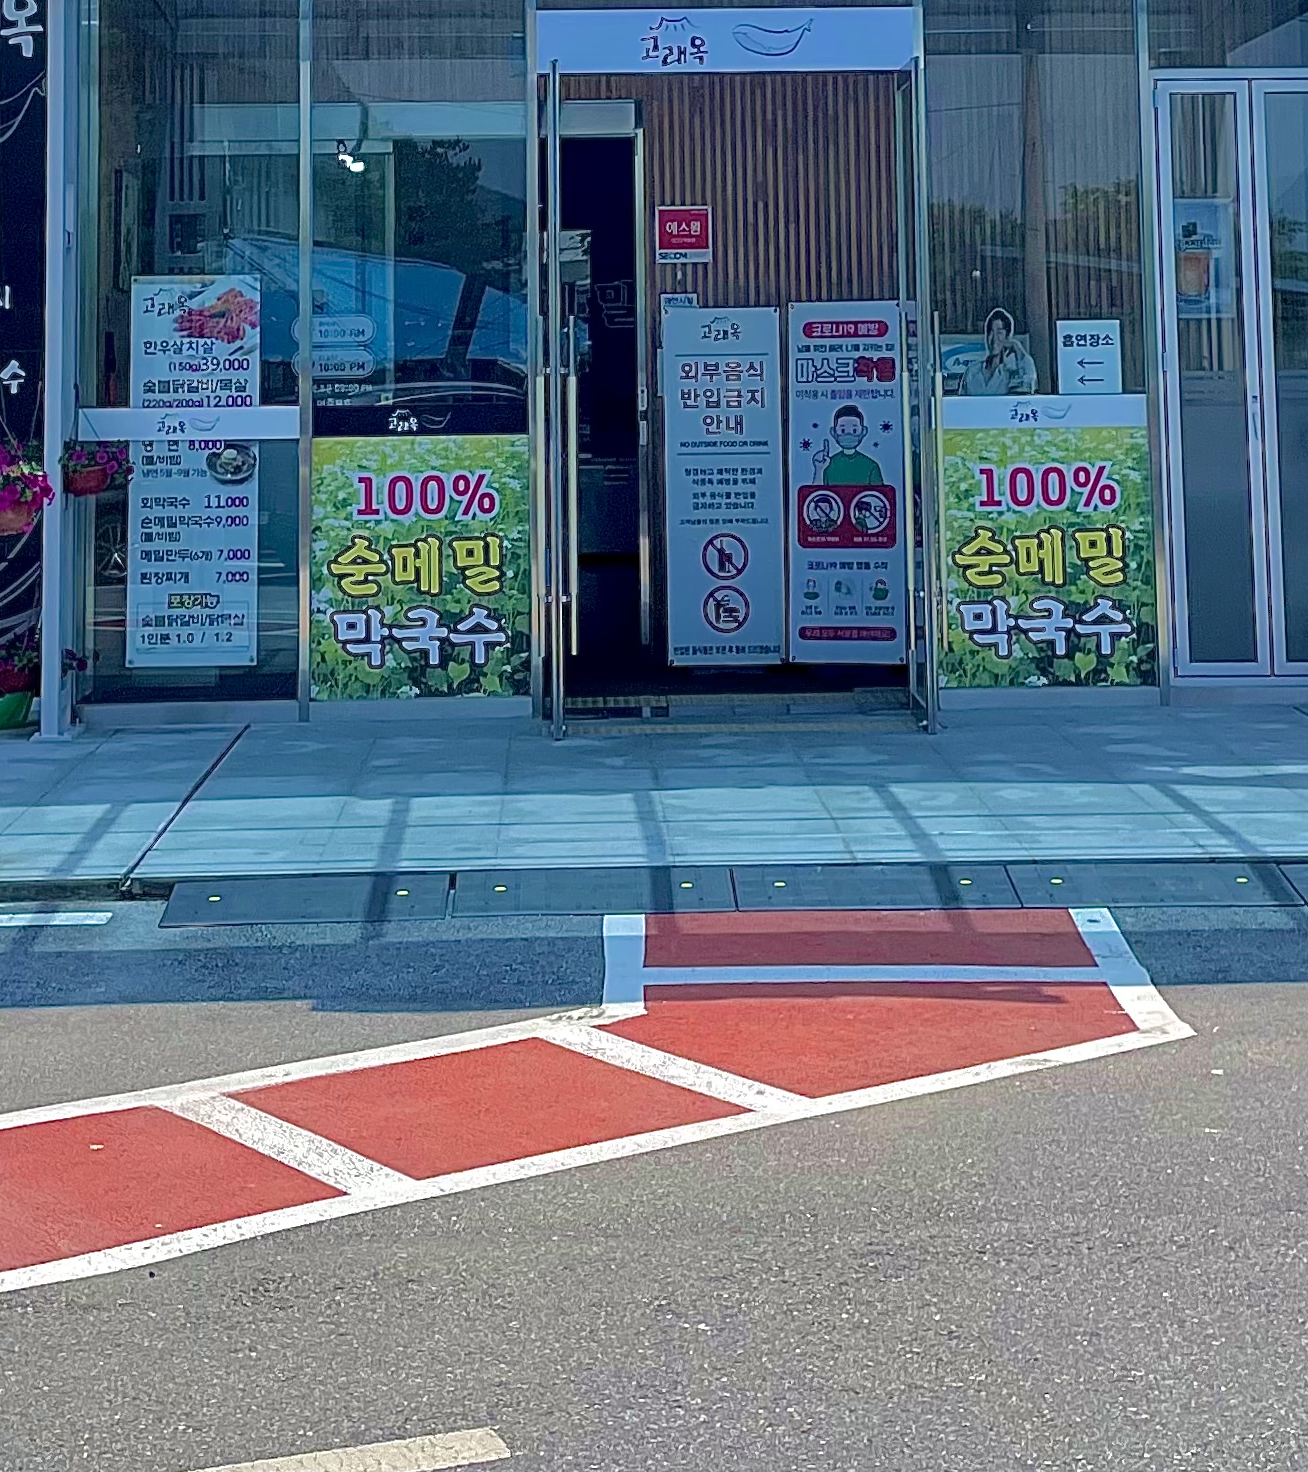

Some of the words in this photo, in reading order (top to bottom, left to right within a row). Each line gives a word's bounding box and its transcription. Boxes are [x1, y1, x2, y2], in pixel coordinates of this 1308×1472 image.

[640, 35, 708, 66] 고래옥
[665, 221, 700, 235] 에스원
[143, 295, 189, 316] 고래옥
[701, 322, 741, 342] 고래옥
[811, 323, 854, 336] 코로나19
[143, 340, 215, 355] 한우살치살
[1061, 332, 1115, 348] 흡연장소
[319, 363, 346, 372] 10:00
[350, 362, 366, 371] PM
[679, 361, 764, 383] 외부음식
[680, 387, 765, 409] 반입금지
[388, 417, 418, 431] 고래옥
[1009, 408, 1039, 422] 고래옥
[156, 420, 186, 435] 고래옥
[702, 415, 744, 435] 안내
[356, 473, 497, 516] 100%
[978, 465, 1117, 508] 100%
[217, 548, 251, 561] 7,000
[953, 526, 1126, 586] 순메밀
[328, 534, 502, 596] 순메밀
[140, 571, 190, 585] 된장찌개
[215, 571, 250, 584] 7,000
[169, 594, 220, 609] 포장가능
[958, 596, 1133, 657] 막국수
[214, 632, 233, 643] 1.2
[331, 606, 507, 667] 막국수
